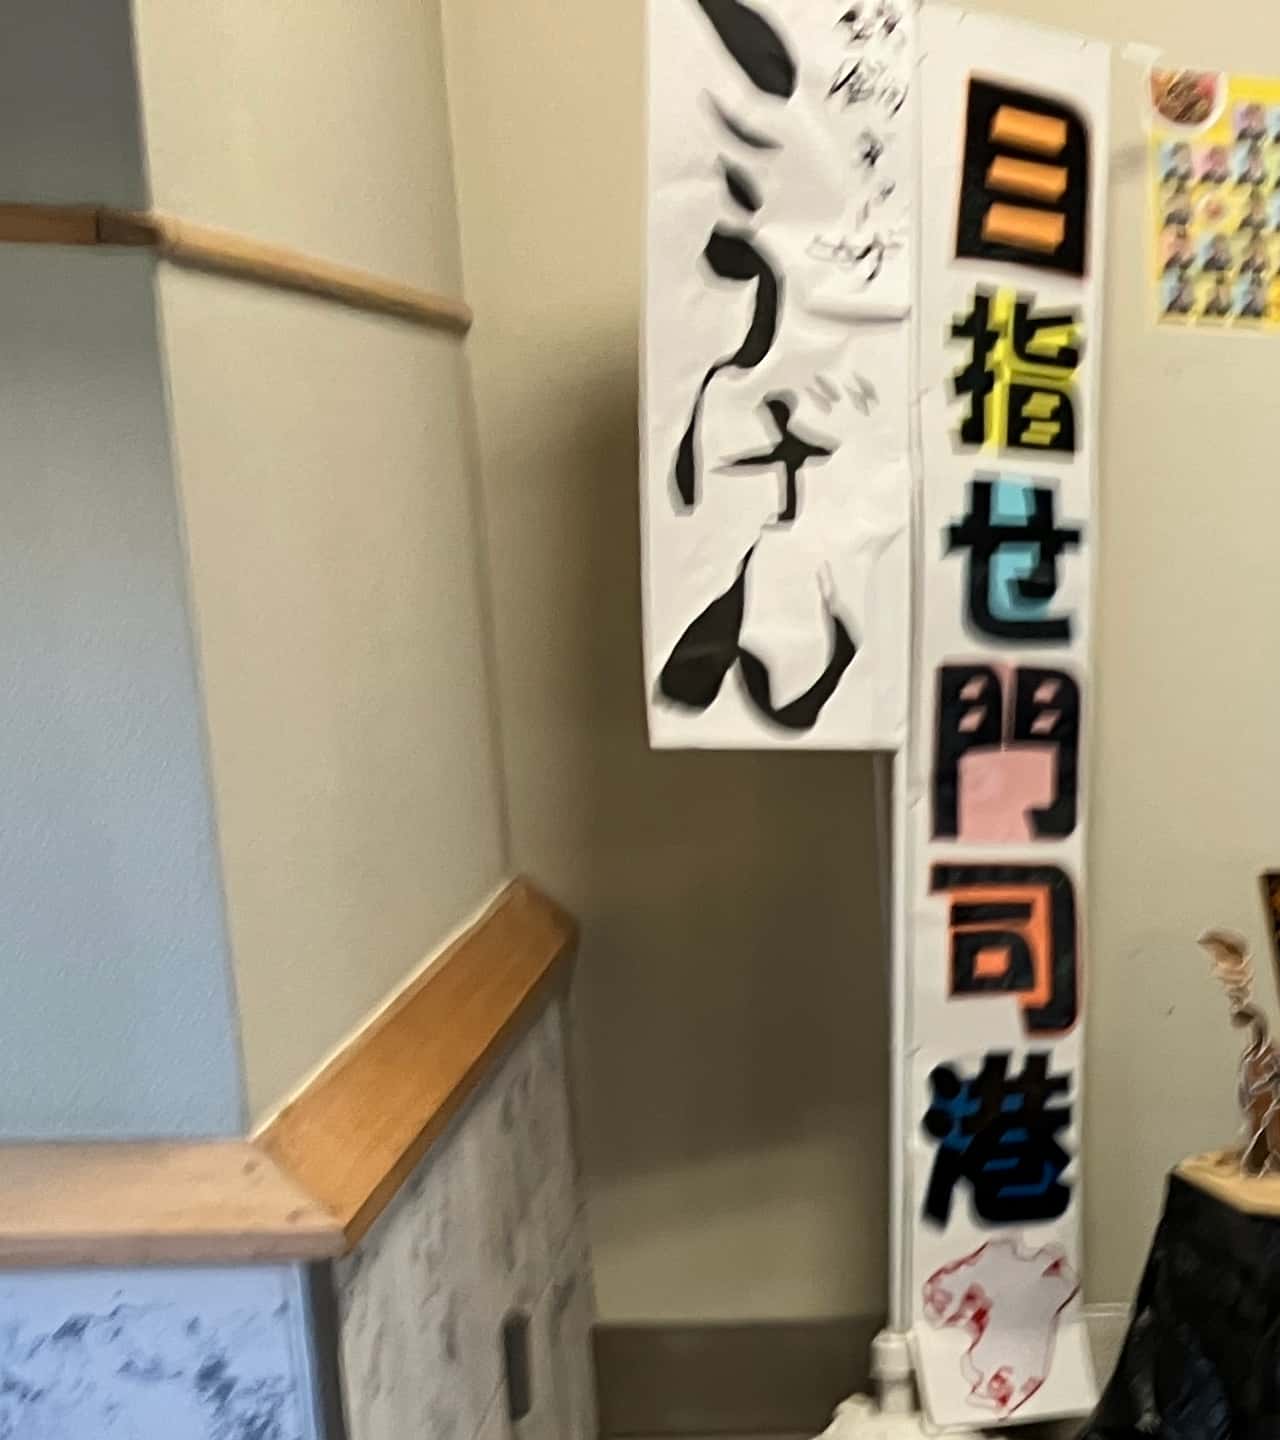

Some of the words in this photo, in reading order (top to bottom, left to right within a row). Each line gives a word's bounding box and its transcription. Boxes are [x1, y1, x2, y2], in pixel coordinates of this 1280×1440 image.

[922, 68, 1090, 1226] 目指せ門司港
